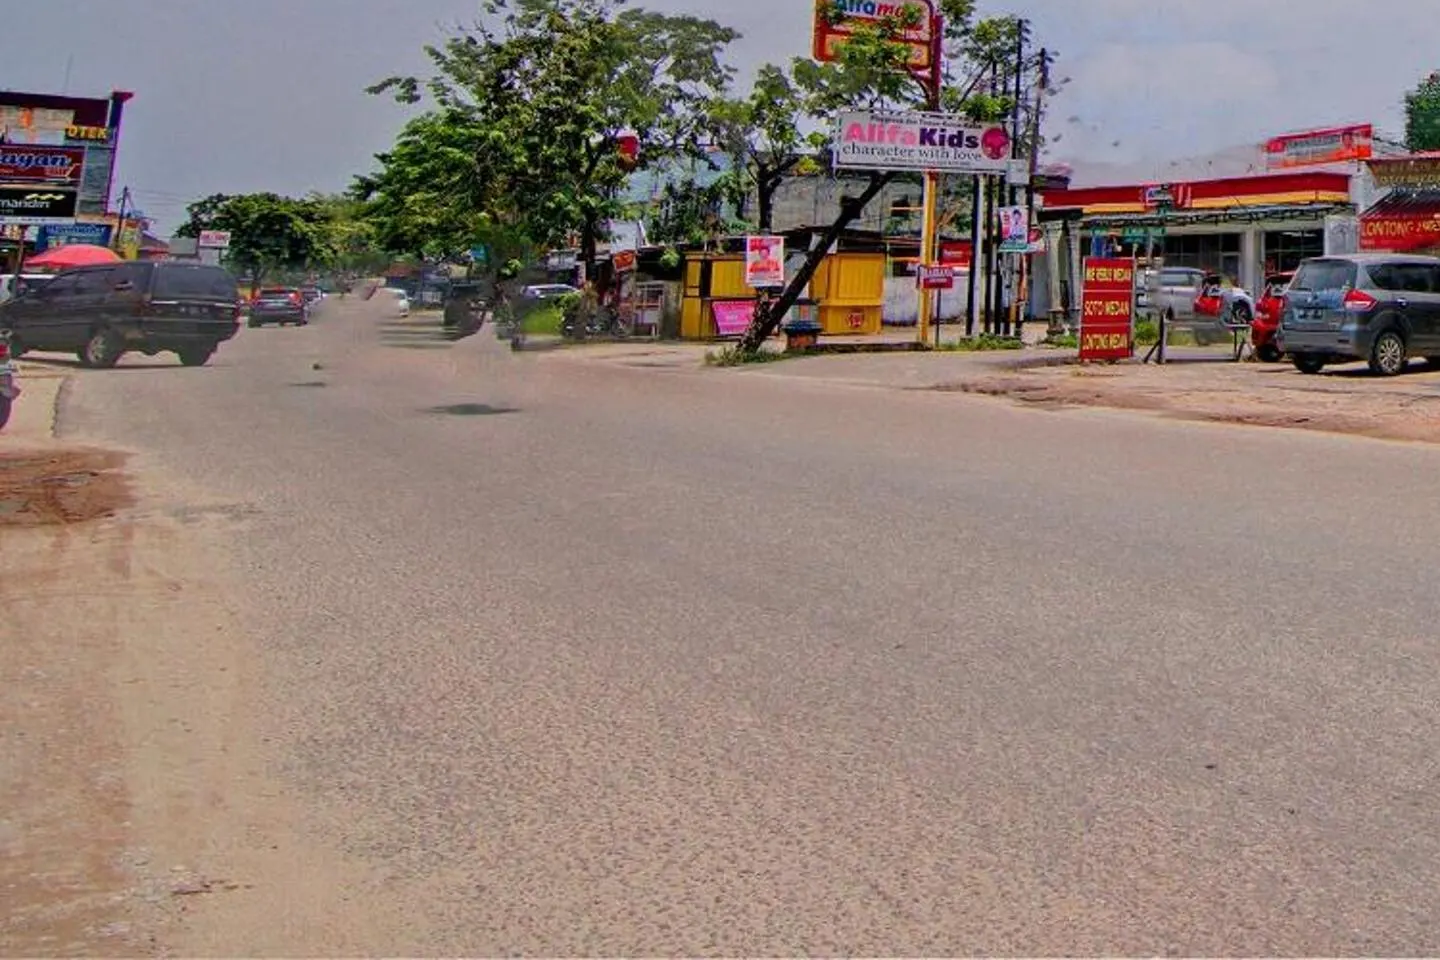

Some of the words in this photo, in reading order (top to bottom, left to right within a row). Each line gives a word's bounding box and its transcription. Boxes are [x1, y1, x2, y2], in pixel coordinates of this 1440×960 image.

[919, 128, 979, 148] Kids
[843, 142, 914, 157] character
[919, 148, 949, 159] with
[953, 149, 982, 161] love
[1361, 220, 1415, 237] LONTONG
